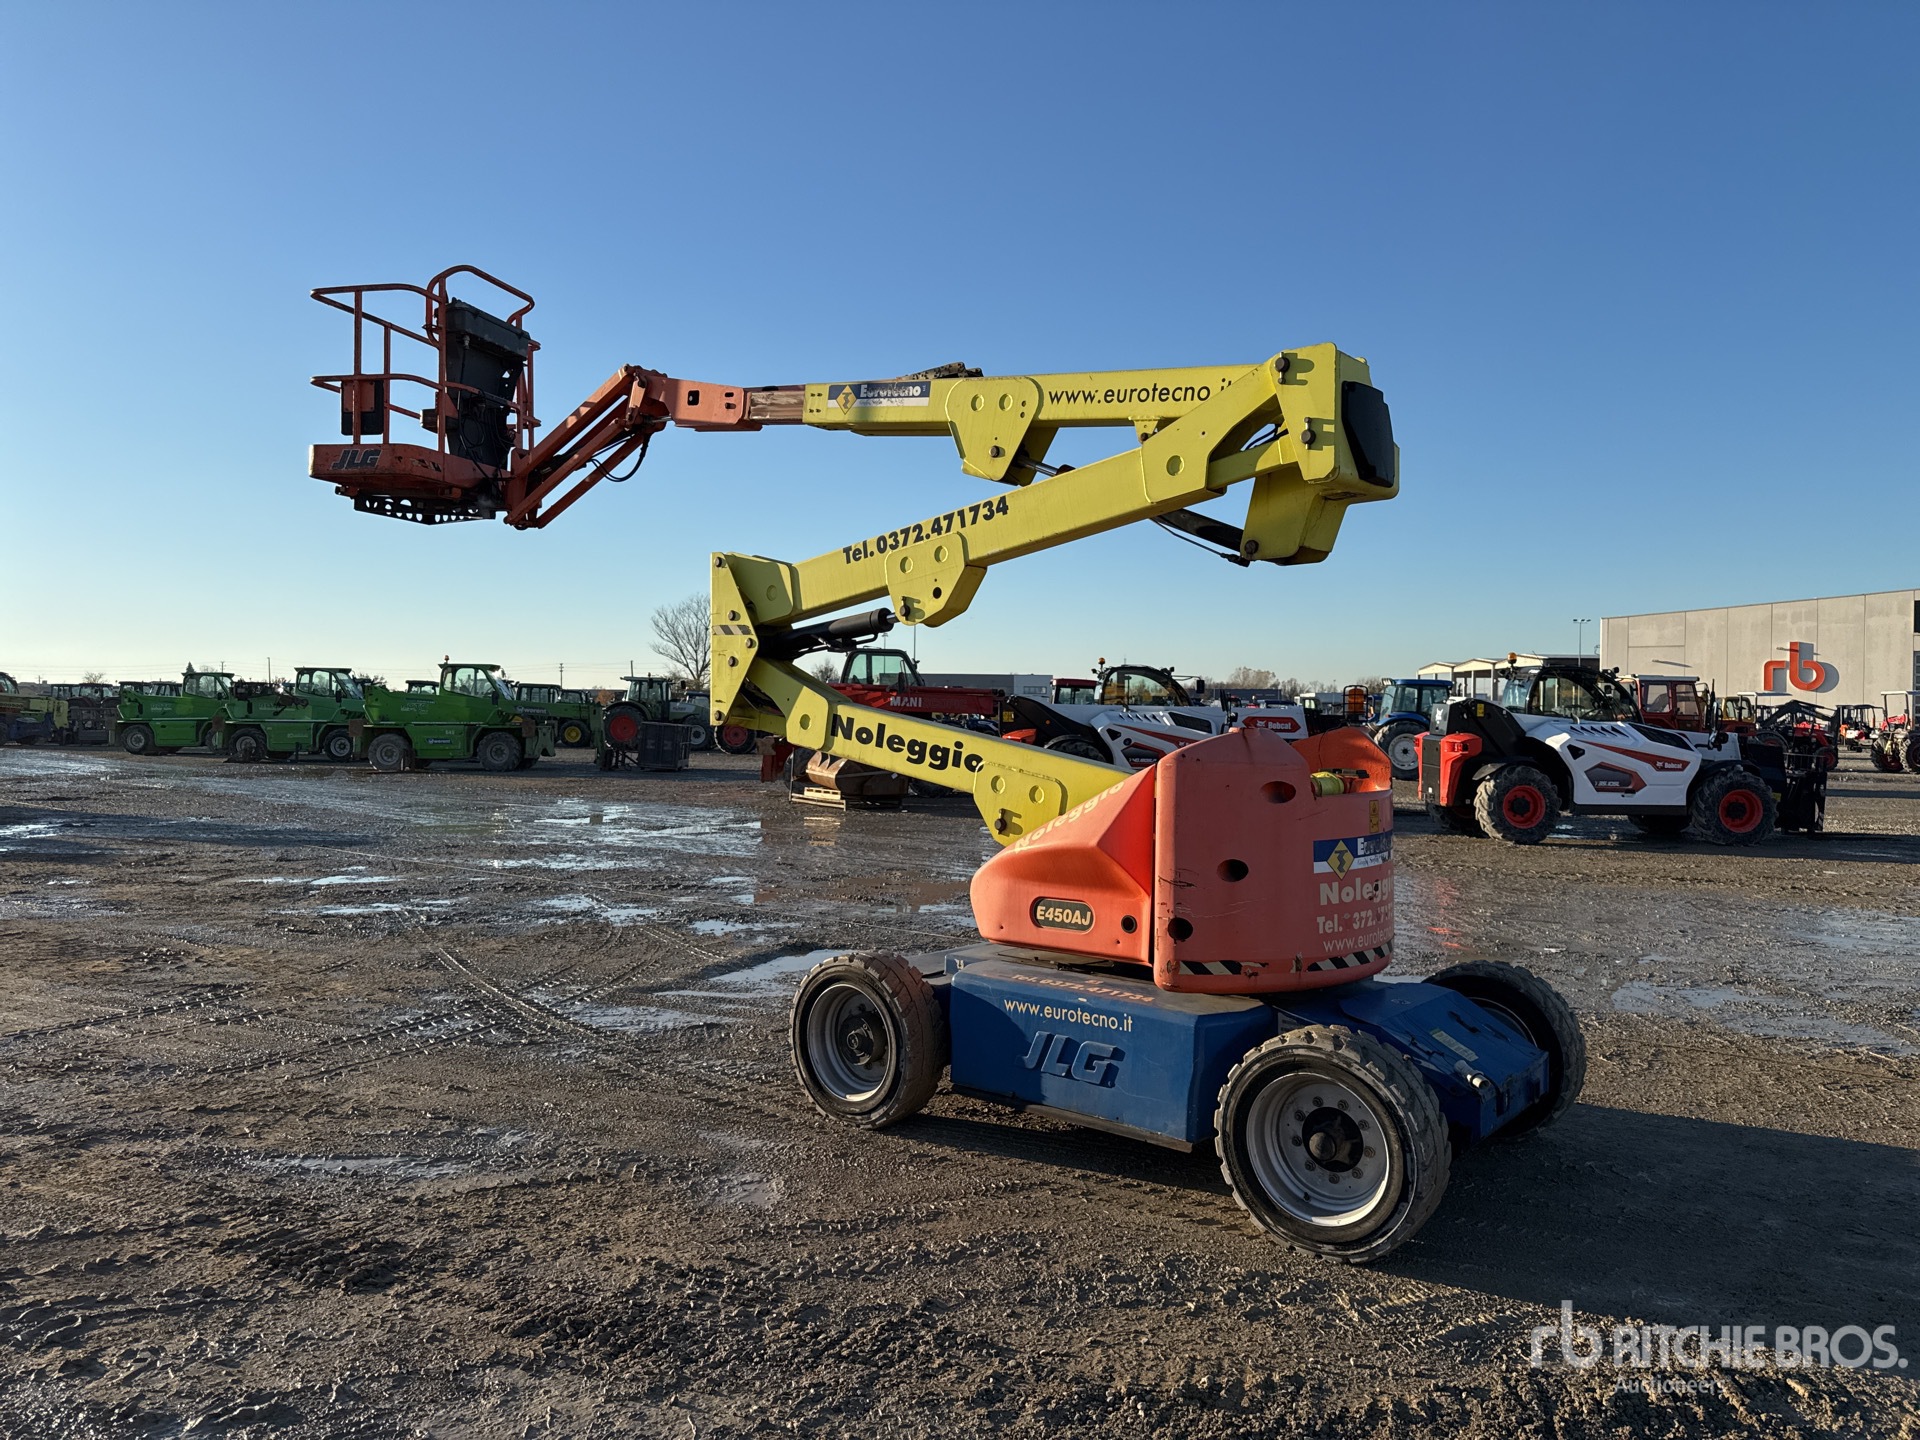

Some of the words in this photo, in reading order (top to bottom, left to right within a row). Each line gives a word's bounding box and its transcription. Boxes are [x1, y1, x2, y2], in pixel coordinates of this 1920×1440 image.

[330, 449, 383, 470] JLG
[1268, 722, 1292, 730] Bobcat
[831, 713, 985, 773] Noleggio
[1014, 781, 1125, 855] Noleggio
[1036, 905, 1092, 926] E450AJ
[1316, 913, 1343, 934] Tel.
[1004, 999, 1133, 1032] www.eurotecno.it
[1024, 1030, 1120, 1085] JLG
